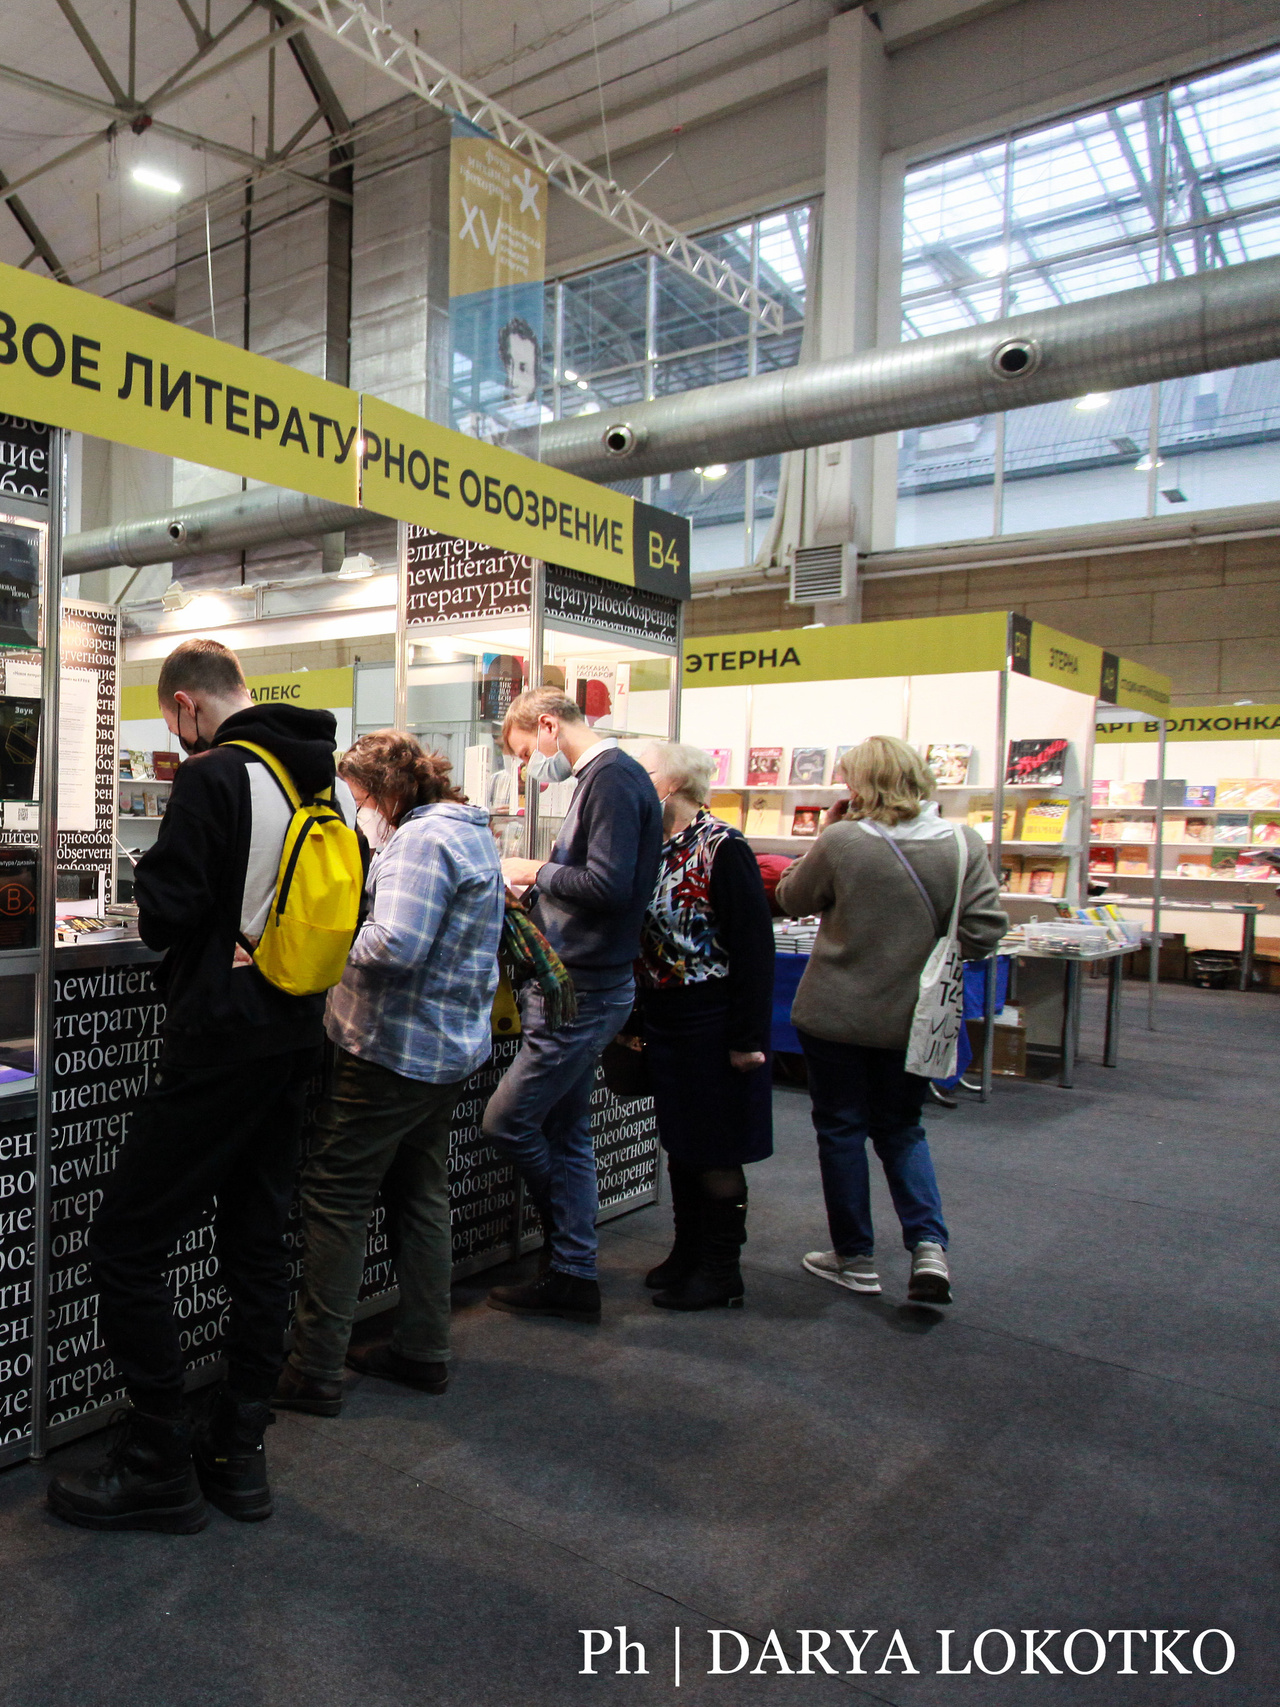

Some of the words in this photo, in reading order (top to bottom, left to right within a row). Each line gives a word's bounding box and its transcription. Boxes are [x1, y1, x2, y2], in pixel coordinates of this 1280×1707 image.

[459, 197, 501, 256] XV
[118, 350, 450, 499] ЛИТЕРАТУРНОЕ
[460, 468, 624, 555] ОБОЗРЕНИЕ
[0, 583, 17, 591] НОВАЯ
[11, 590, 30, 599] НОРМА
[685, 646, 801, 673] ЭТЕРНА
[576, 664, 610, 672] МИХАИЛ
[576, 670, 614, 678] ГАСПАРОВ
[15, 706, 33, 715] Звук
[1144, 716, 1280, 733] ВОЛХОНКА
